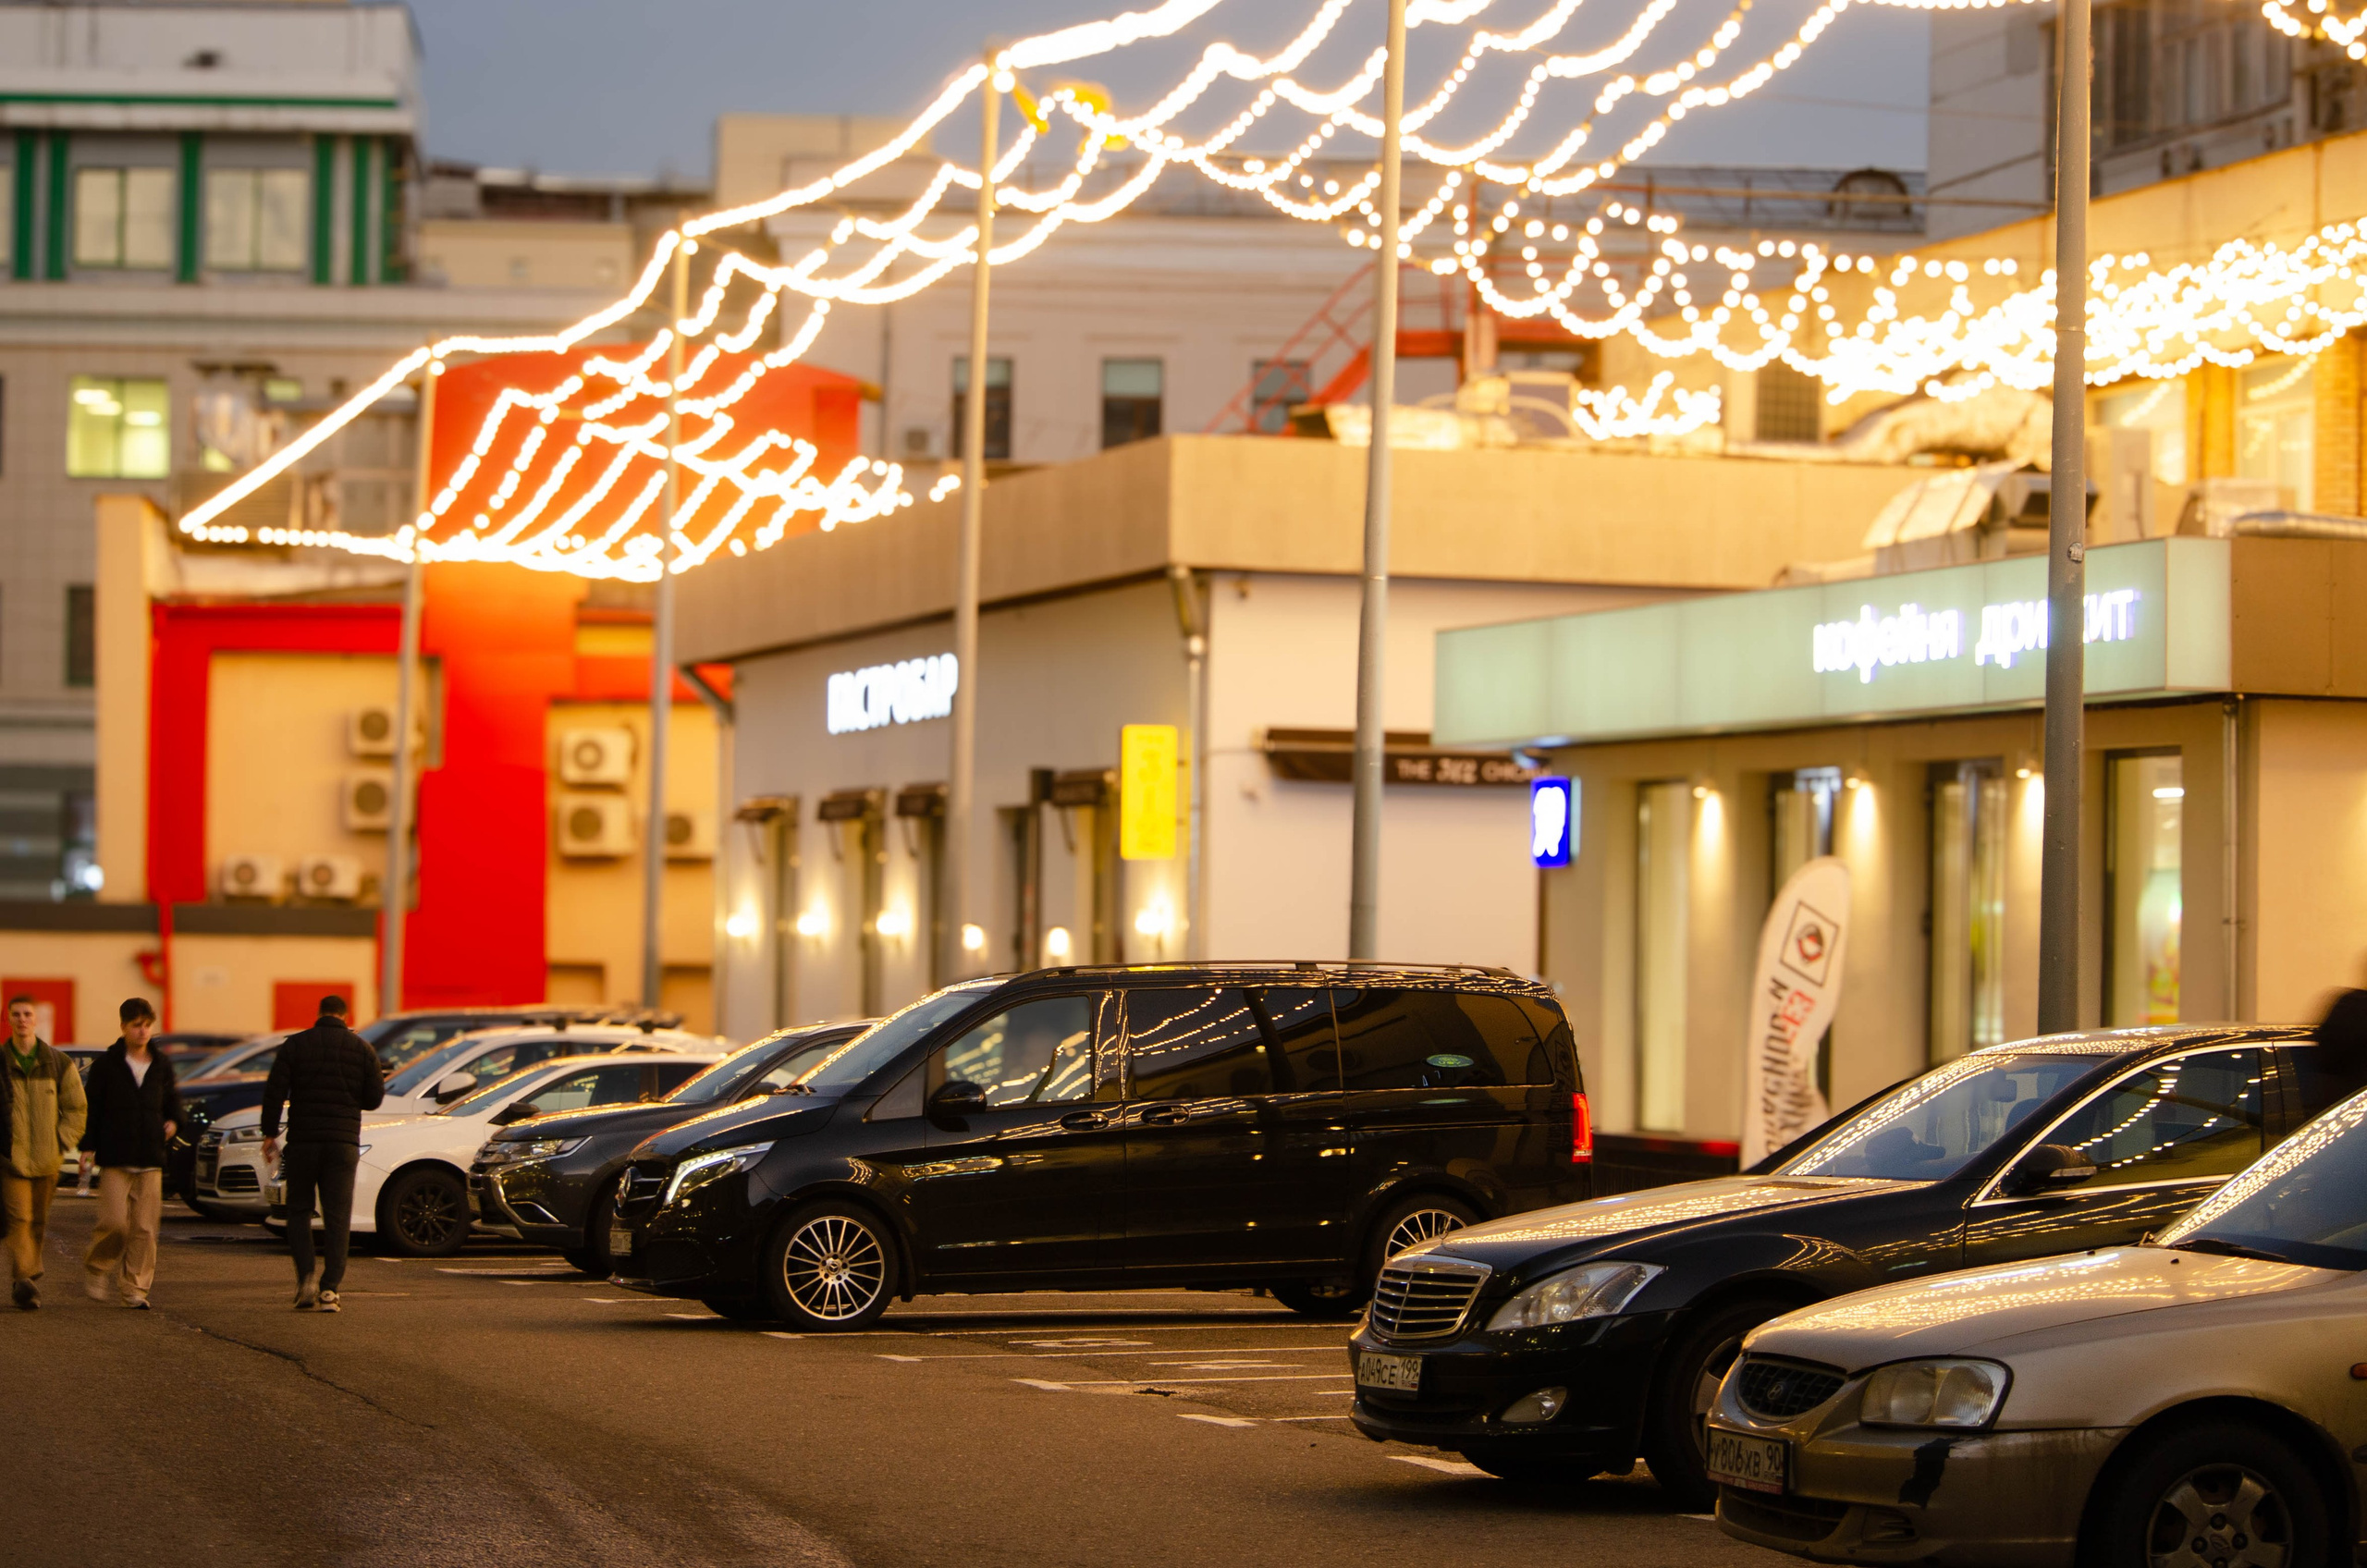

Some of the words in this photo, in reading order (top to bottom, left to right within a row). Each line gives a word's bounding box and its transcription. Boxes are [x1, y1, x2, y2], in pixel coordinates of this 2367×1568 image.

[1813, 604, 1960, 684] кофейня
[1976, 589, 2136, 669] дриит
[1401, 1358, 1418, 1379] 199
[1766, 1444, 1781, 1471] 90
